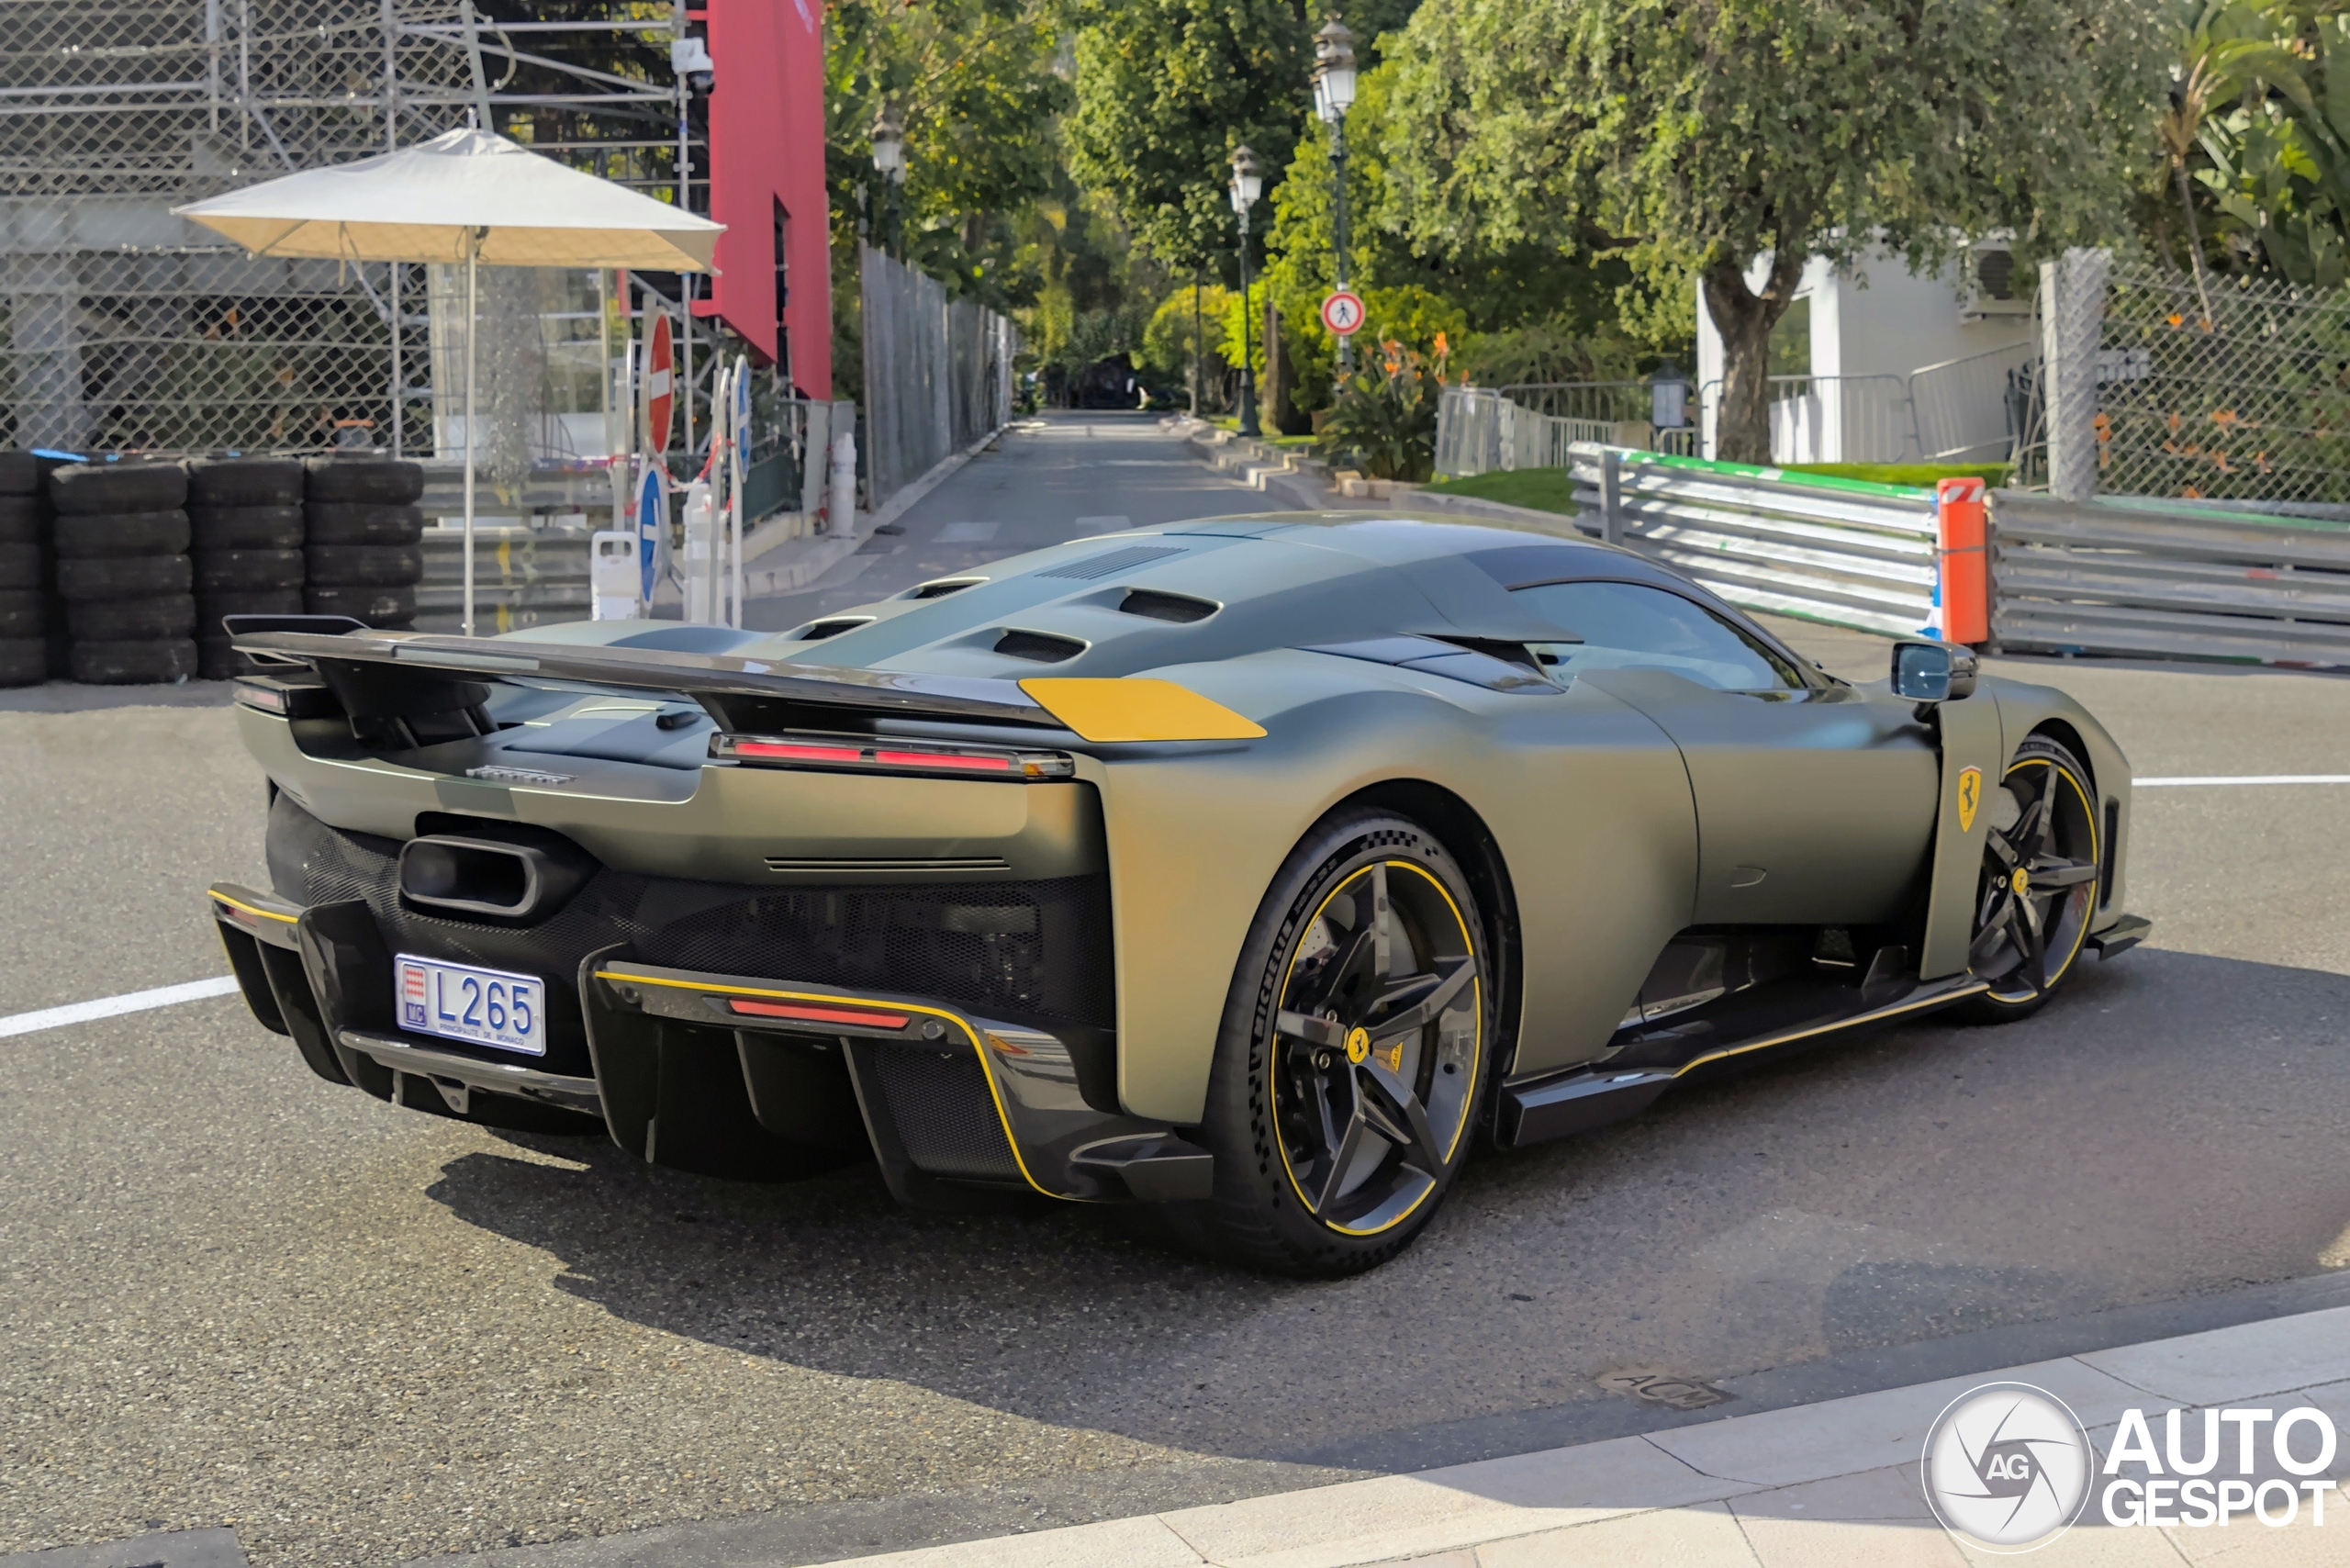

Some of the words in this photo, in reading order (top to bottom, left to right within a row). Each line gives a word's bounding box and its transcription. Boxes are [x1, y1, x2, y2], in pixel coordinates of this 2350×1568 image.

[1254, 919, 1293, 1038] MICHELIN
[408, 1004, 424, 1022] MC
[437, 971, 532, 1035] L265
[484, 1031, 491, 1039] DE
[497, 1034, 524, 1046] MONACO
